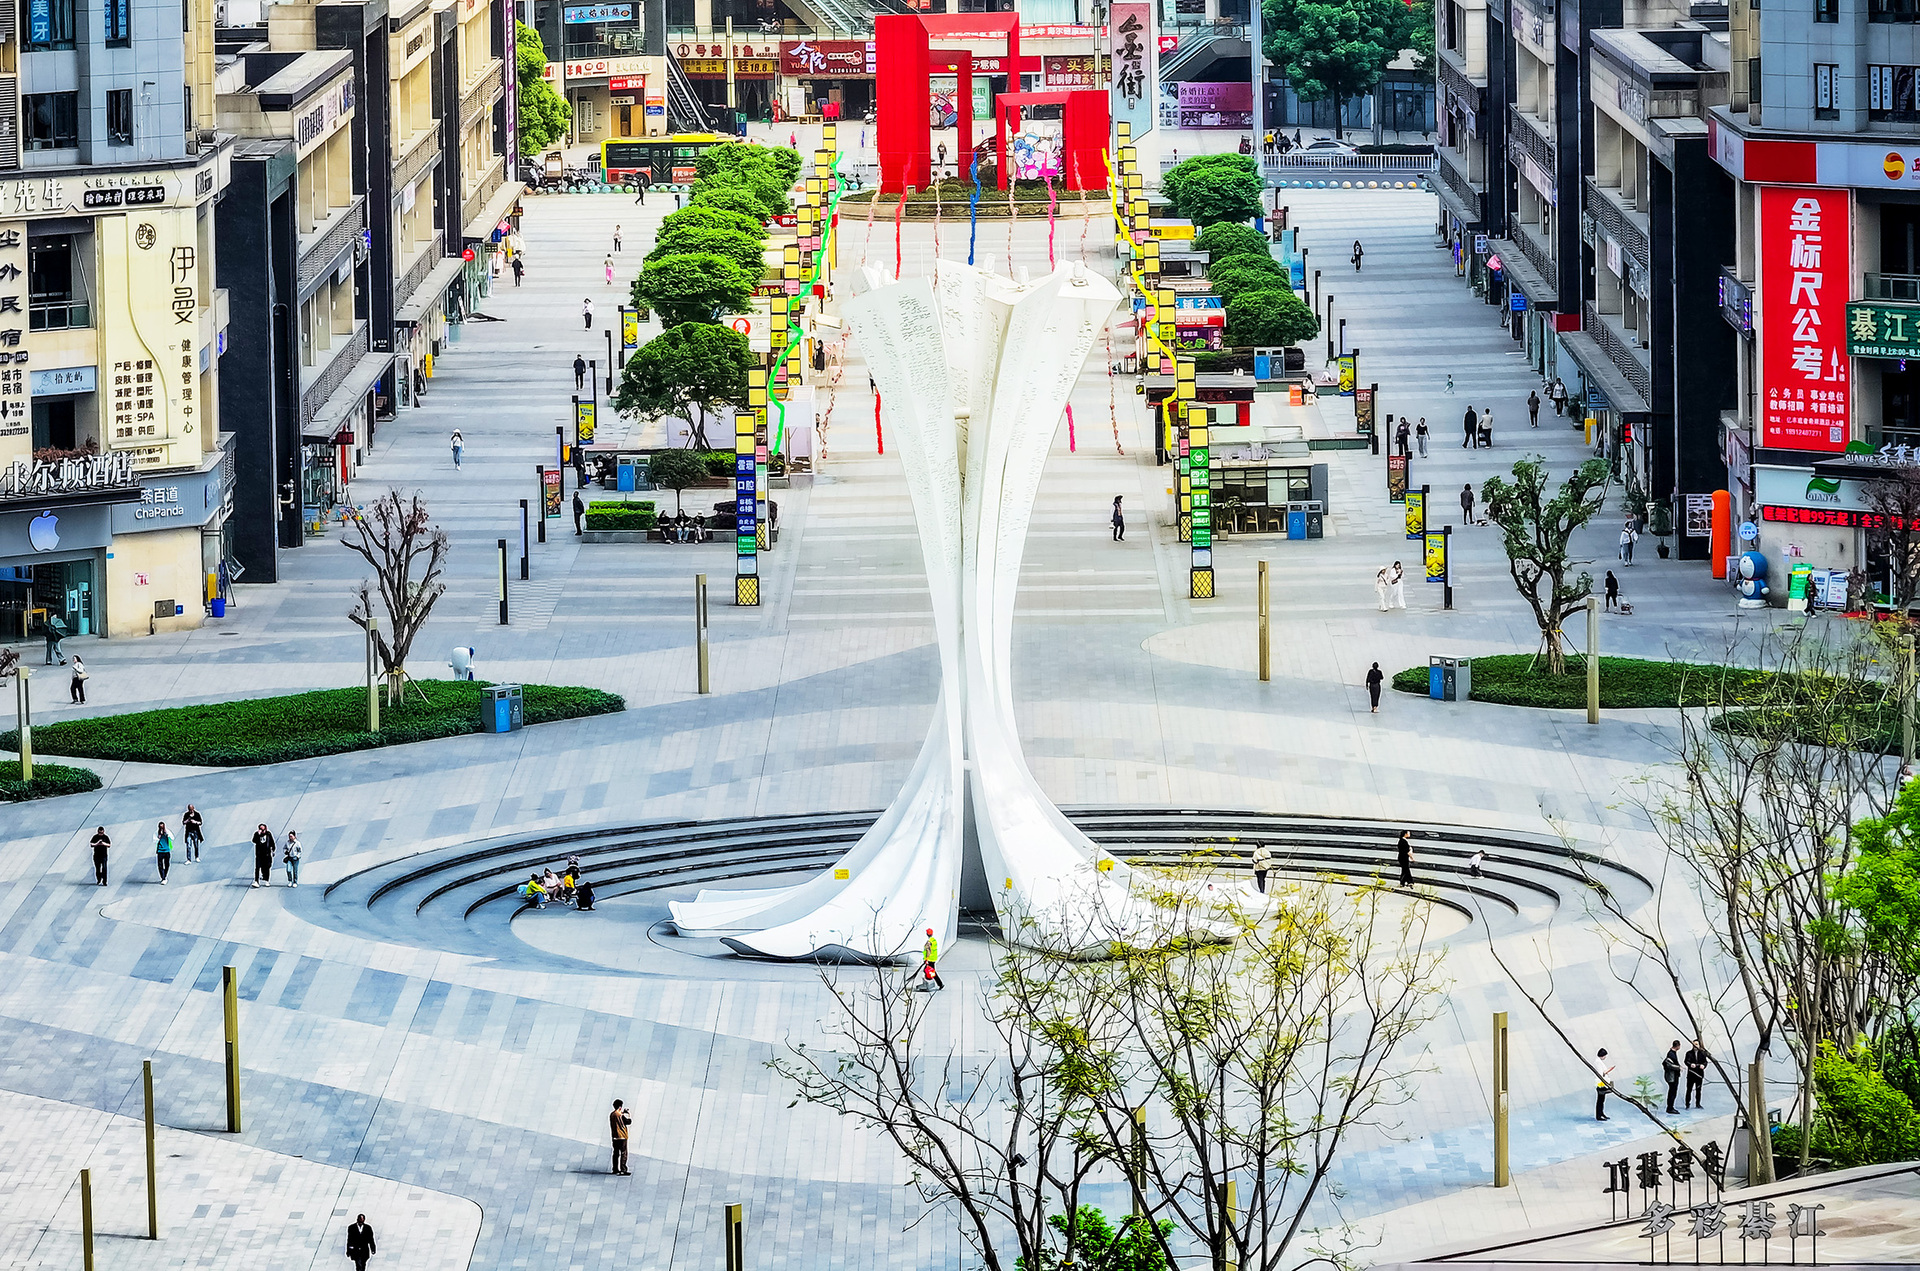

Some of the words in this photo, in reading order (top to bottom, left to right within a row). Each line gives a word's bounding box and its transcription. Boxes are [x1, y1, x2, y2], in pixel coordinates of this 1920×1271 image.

[32, 0, 48, 40] 美牙
[0, 229, 23, 348] 尘外民宿
[170, 246, 196, 325] 伊曼
[1789, 198, 1823, 380] 金标尺公考
[1851, 308, 1920, 343] 綦江
[2, 369, 22, 382] 城市
[2, 382, 22, 395] 民宿
[181, 338, 194, 433] 健康管理中心
[1769, 399, 1805, 412] 教师招聘
[1810, 402, 1845, 414] 考前培训
[1810, 389, 1845, 402] 事业单位
[134, 504, 185, 519] ChaPanda
[140, 485, 179, 505] 茶百道
[1639, 1200, 1826, 1239] 多彩綦江
